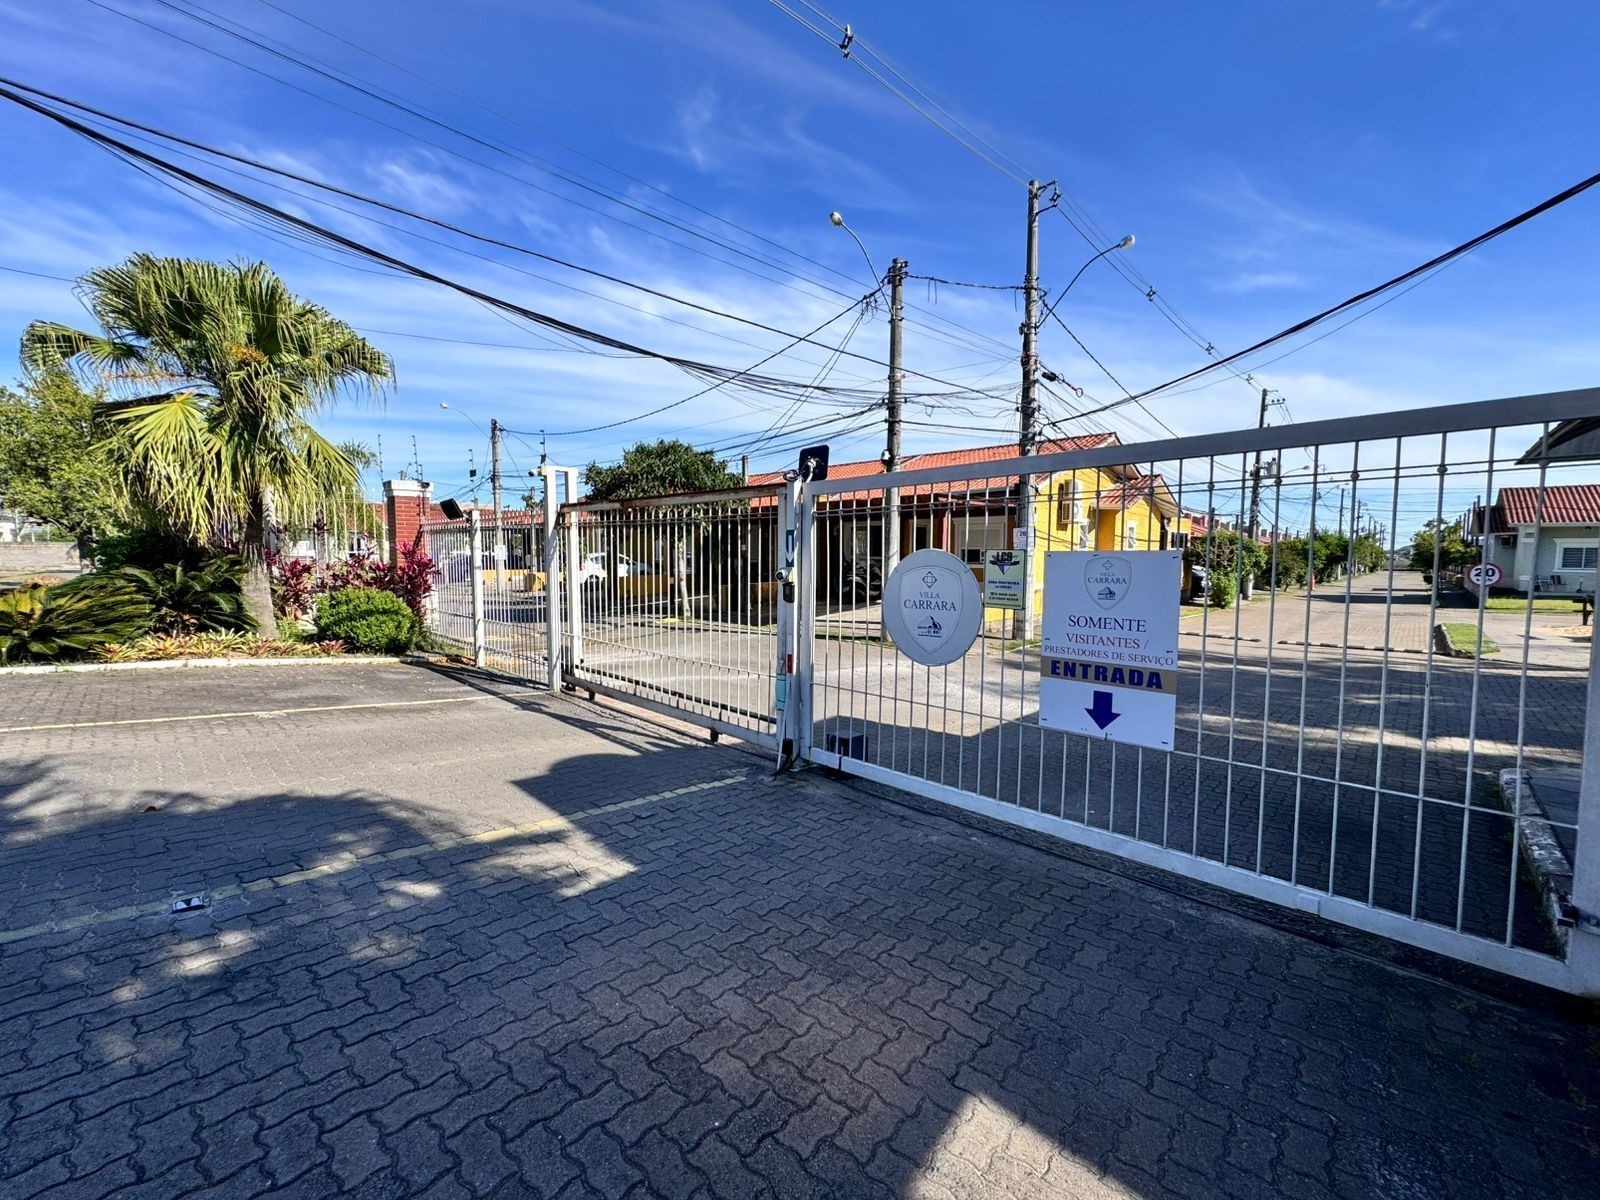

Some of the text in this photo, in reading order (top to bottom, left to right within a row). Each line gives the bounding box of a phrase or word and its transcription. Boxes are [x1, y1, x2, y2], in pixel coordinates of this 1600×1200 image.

[1087, 576, 1127, 585] CARRARA
[1474, 568, 1496, 577] 20
[919, 591, 941, 599] VILLA
[903, 598, 957, 612] CARRARA
[1068, 614, 1147, 633] SOMENTE
[1066, 632, 1140, 650] VISITANTES
[1043, 644, 1174, 667] PRESTADORES DE SERVIÇO
[1050, 659, 1163, 690] ENTRADA
